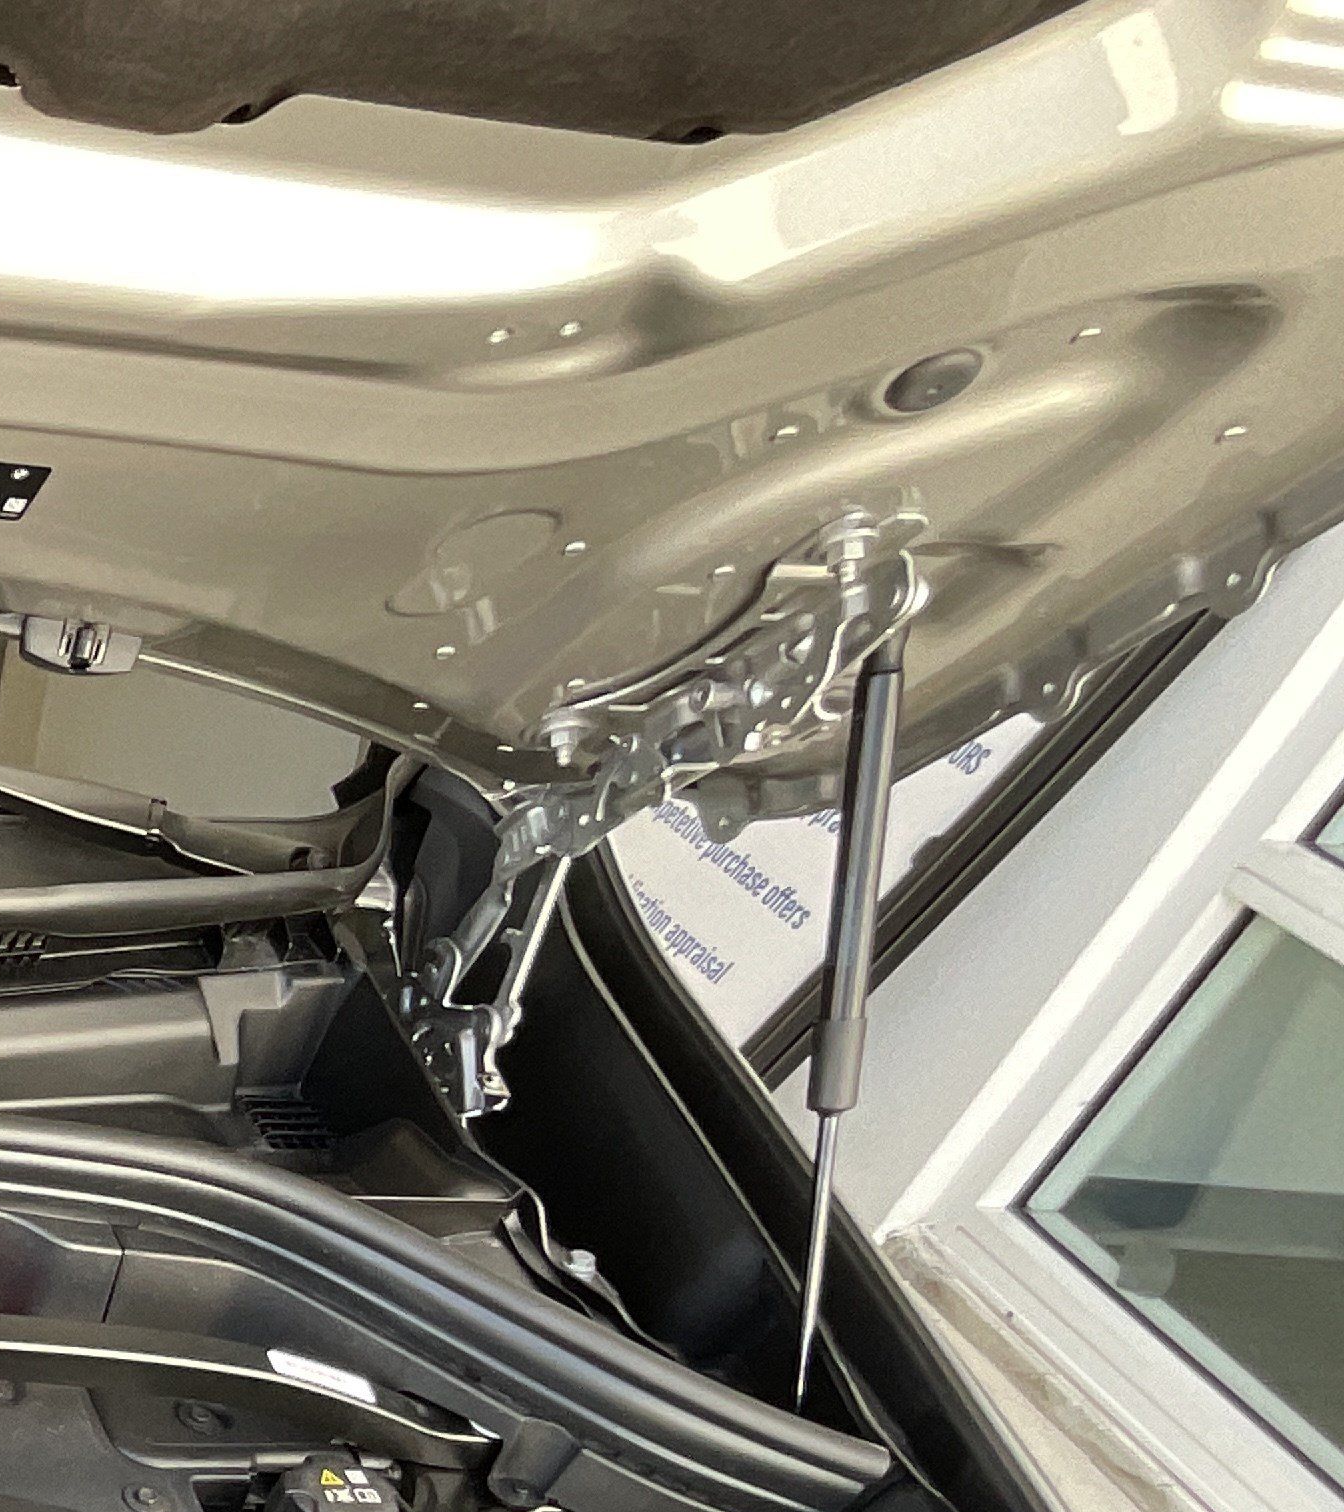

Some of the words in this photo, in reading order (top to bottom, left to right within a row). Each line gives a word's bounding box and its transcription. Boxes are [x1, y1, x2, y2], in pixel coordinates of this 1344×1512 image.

[697, 842, 770, 898] purchase
[761, 884, 812, 930] offers
[664, 923, 735, 984] appraisal
